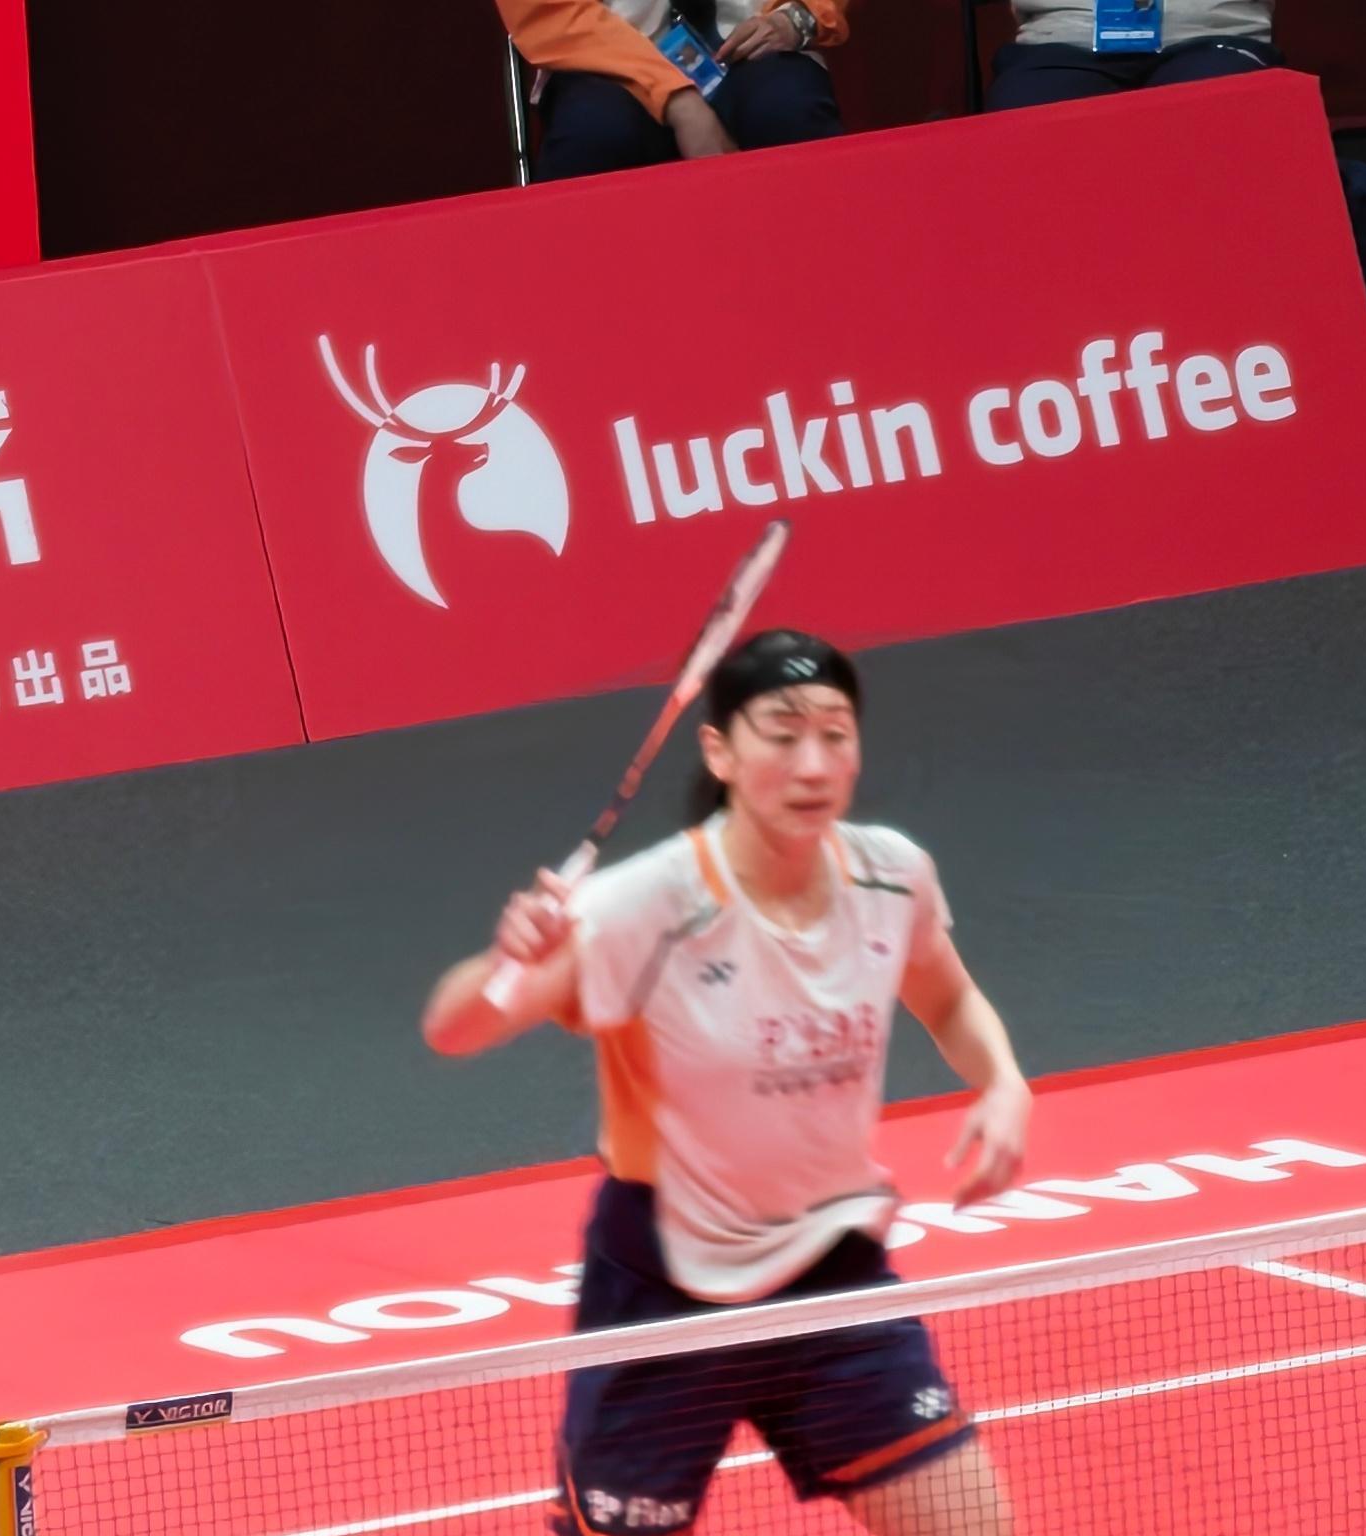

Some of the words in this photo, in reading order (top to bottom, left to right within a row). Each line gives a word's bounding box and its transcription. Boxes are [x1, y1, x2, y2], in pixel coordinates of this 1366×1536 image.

[612, 381, 942, 525] luckin
[966, 331, 1297, 465] coffee
[158, 1399, 231, 1421] VICTOR
